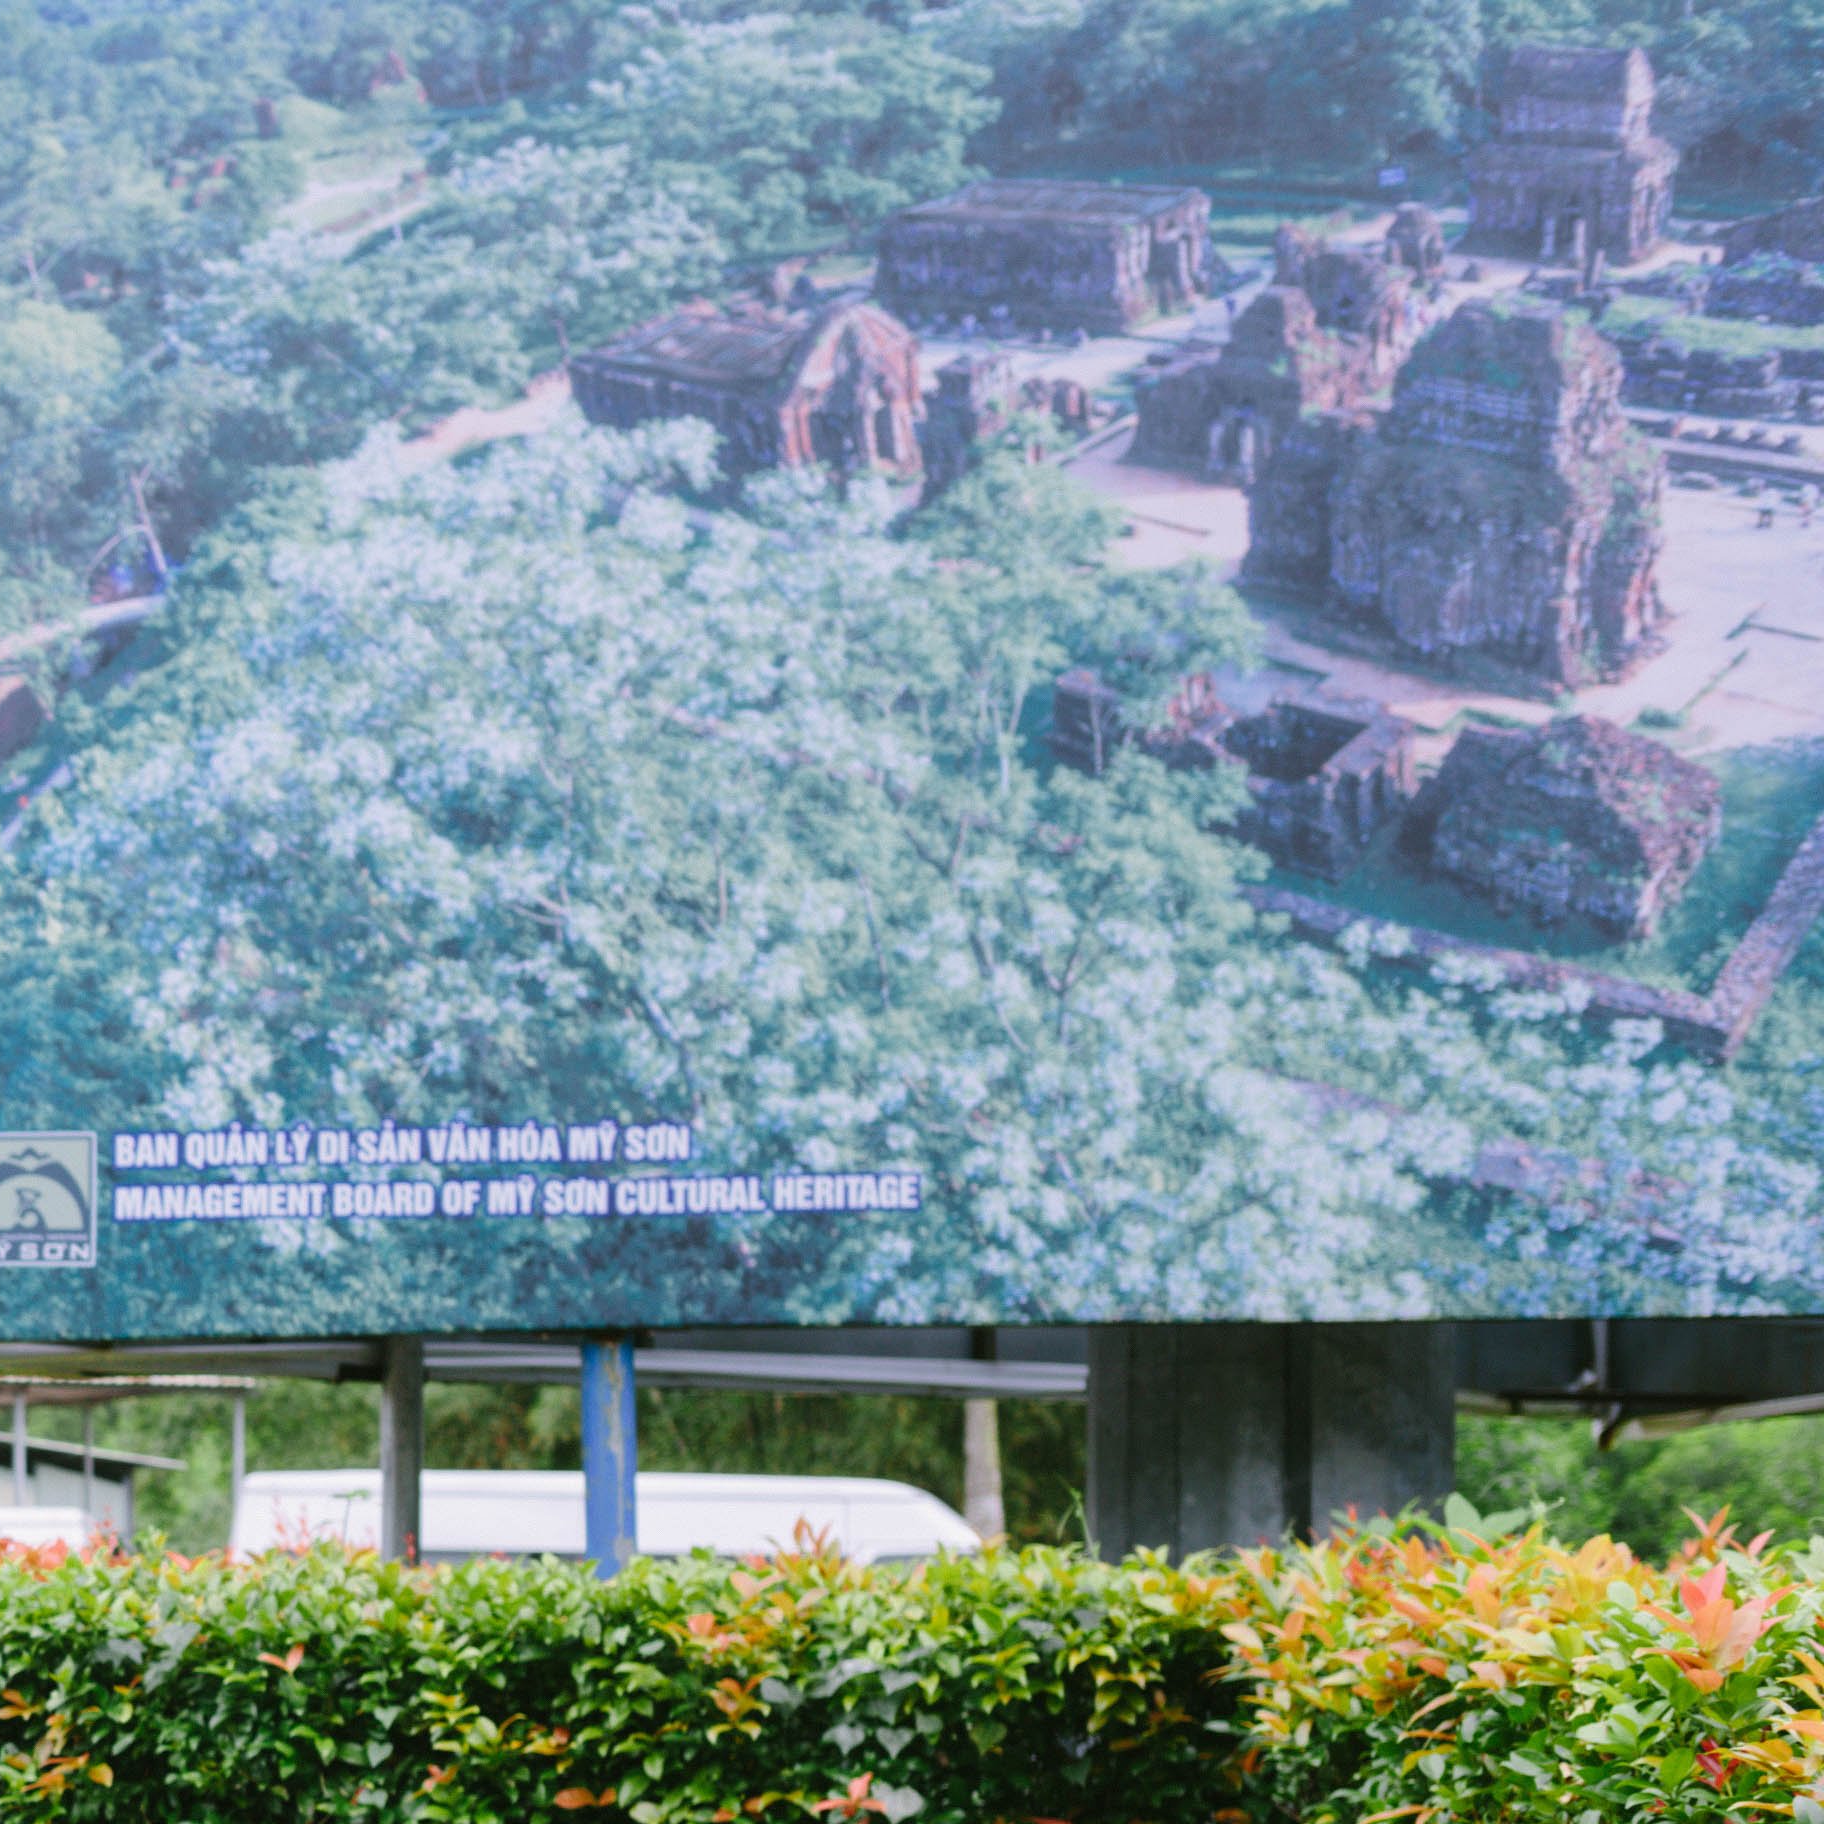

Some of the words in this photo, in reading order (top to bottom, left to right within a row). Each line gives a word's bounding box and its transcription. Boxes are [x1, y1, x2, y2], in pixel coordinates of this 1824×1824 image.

[115, 1132, 178, 1167] BAN
[184, 1121, 268, 1169] QUẢN
[275, 1122, 313, 1164] LÝ
[317, 1129, 350, 1163] DI
[356, 1118, 421, 1163] SẢN
[427, 1122, 491, 1162] VĂN
[497, 1120, 562, 1161] HÓA
[568, 1119, 618, 1161] MỸ
[115, 1183, 327, 1220] MANAGEMENT
[332, 1182, 436, 1217] BOARD
[441, 1180, 482, 1215] OF
[487, 1174, 538, 1214] MỸ
[615, 1175, 767, 1214] CULTURAL
[772, 1174, 920, 1210] HERITAGE
